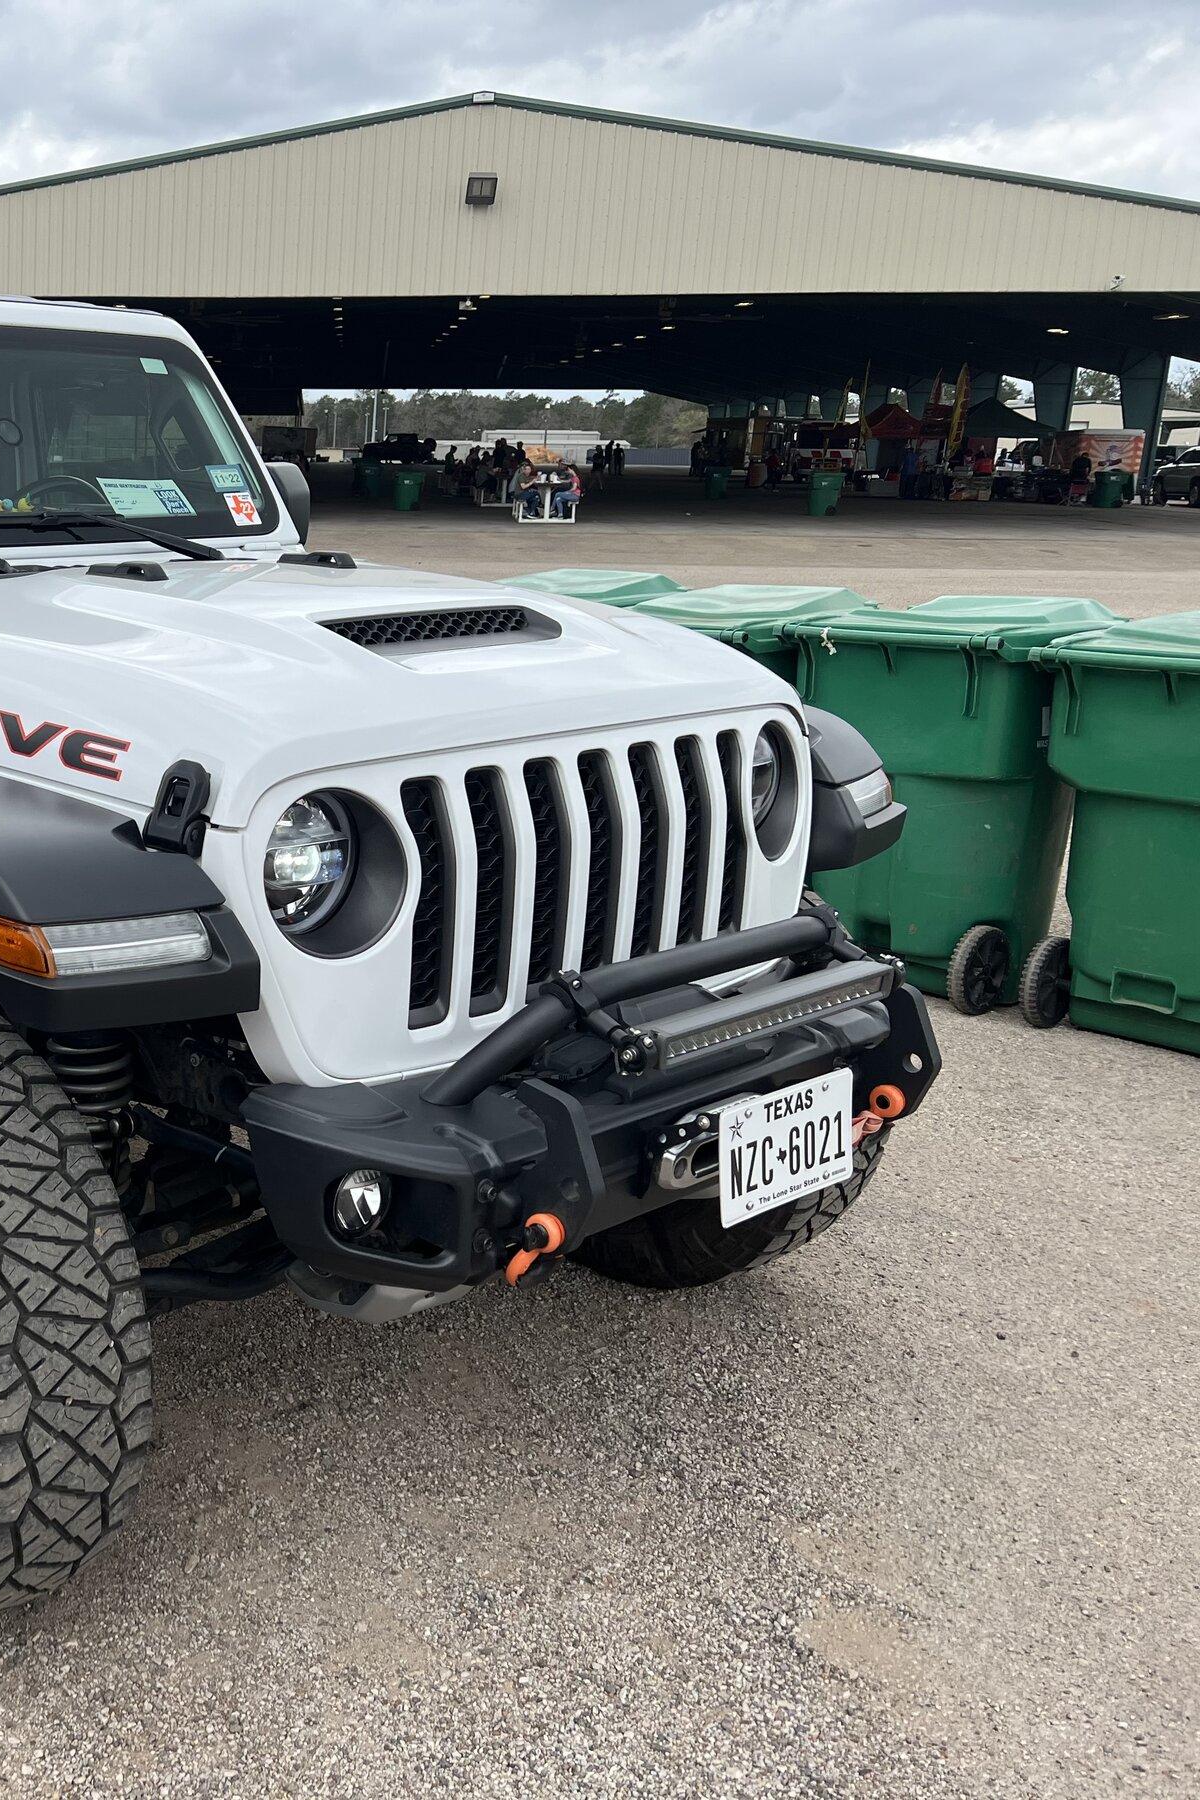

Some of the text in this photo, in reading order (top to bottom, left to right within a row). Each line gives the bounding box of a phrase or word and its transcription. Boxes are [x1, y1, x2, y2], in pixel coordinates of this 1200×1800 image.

[214, 473, 241, 484] 11 22
[155, 490, 180, 499] LOOK
[240, 503, 254, 514] 22
[763, 1088, 813, 1123] TEXAS
[730, 1110, 846, 1200] NZC 6021
[758, 1177, 820, 1205] The Lone Star State
